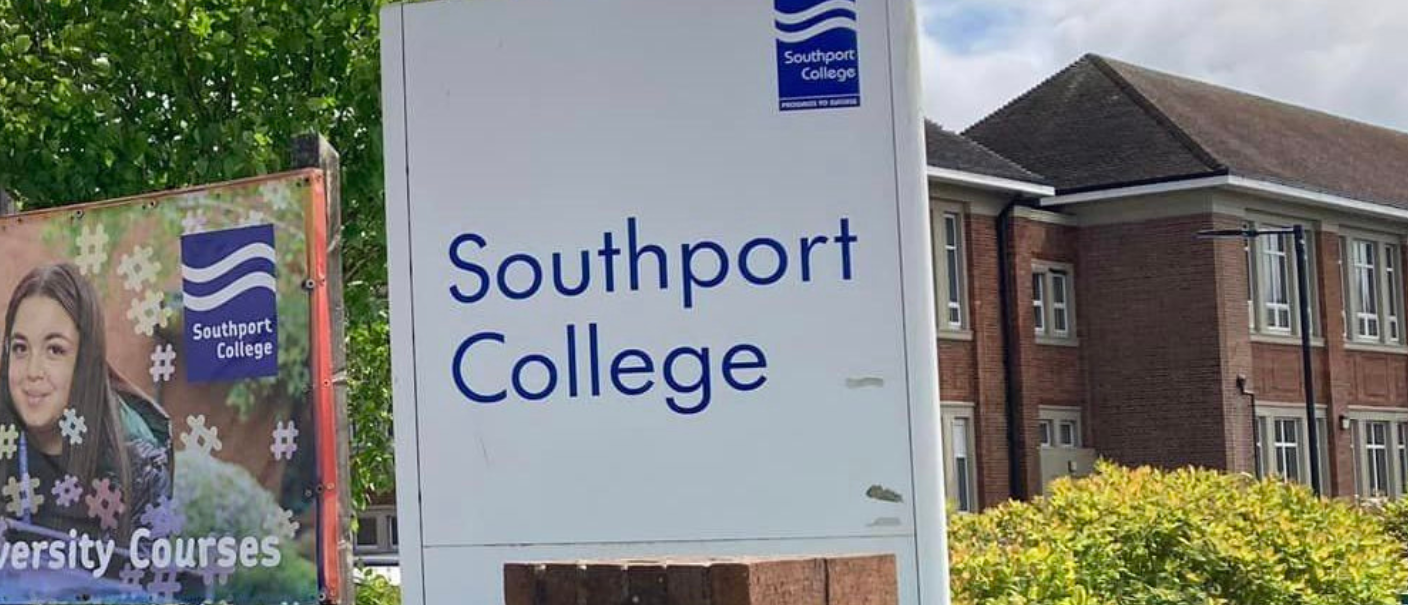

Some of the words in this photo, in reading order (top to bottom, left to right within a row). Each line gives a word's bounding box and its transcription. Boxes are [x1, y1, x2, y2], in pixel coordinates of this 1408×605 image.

[783, 49, 856, 65] Southport
[801, 66, 856, 82] College
[449, 216, 858, 309] Southport
[192, 318, 273, 340] Southport
[216, 341, 273, 360] College
[452, 322, 768, 415] College
[129, 528, 282, 569] Courses
